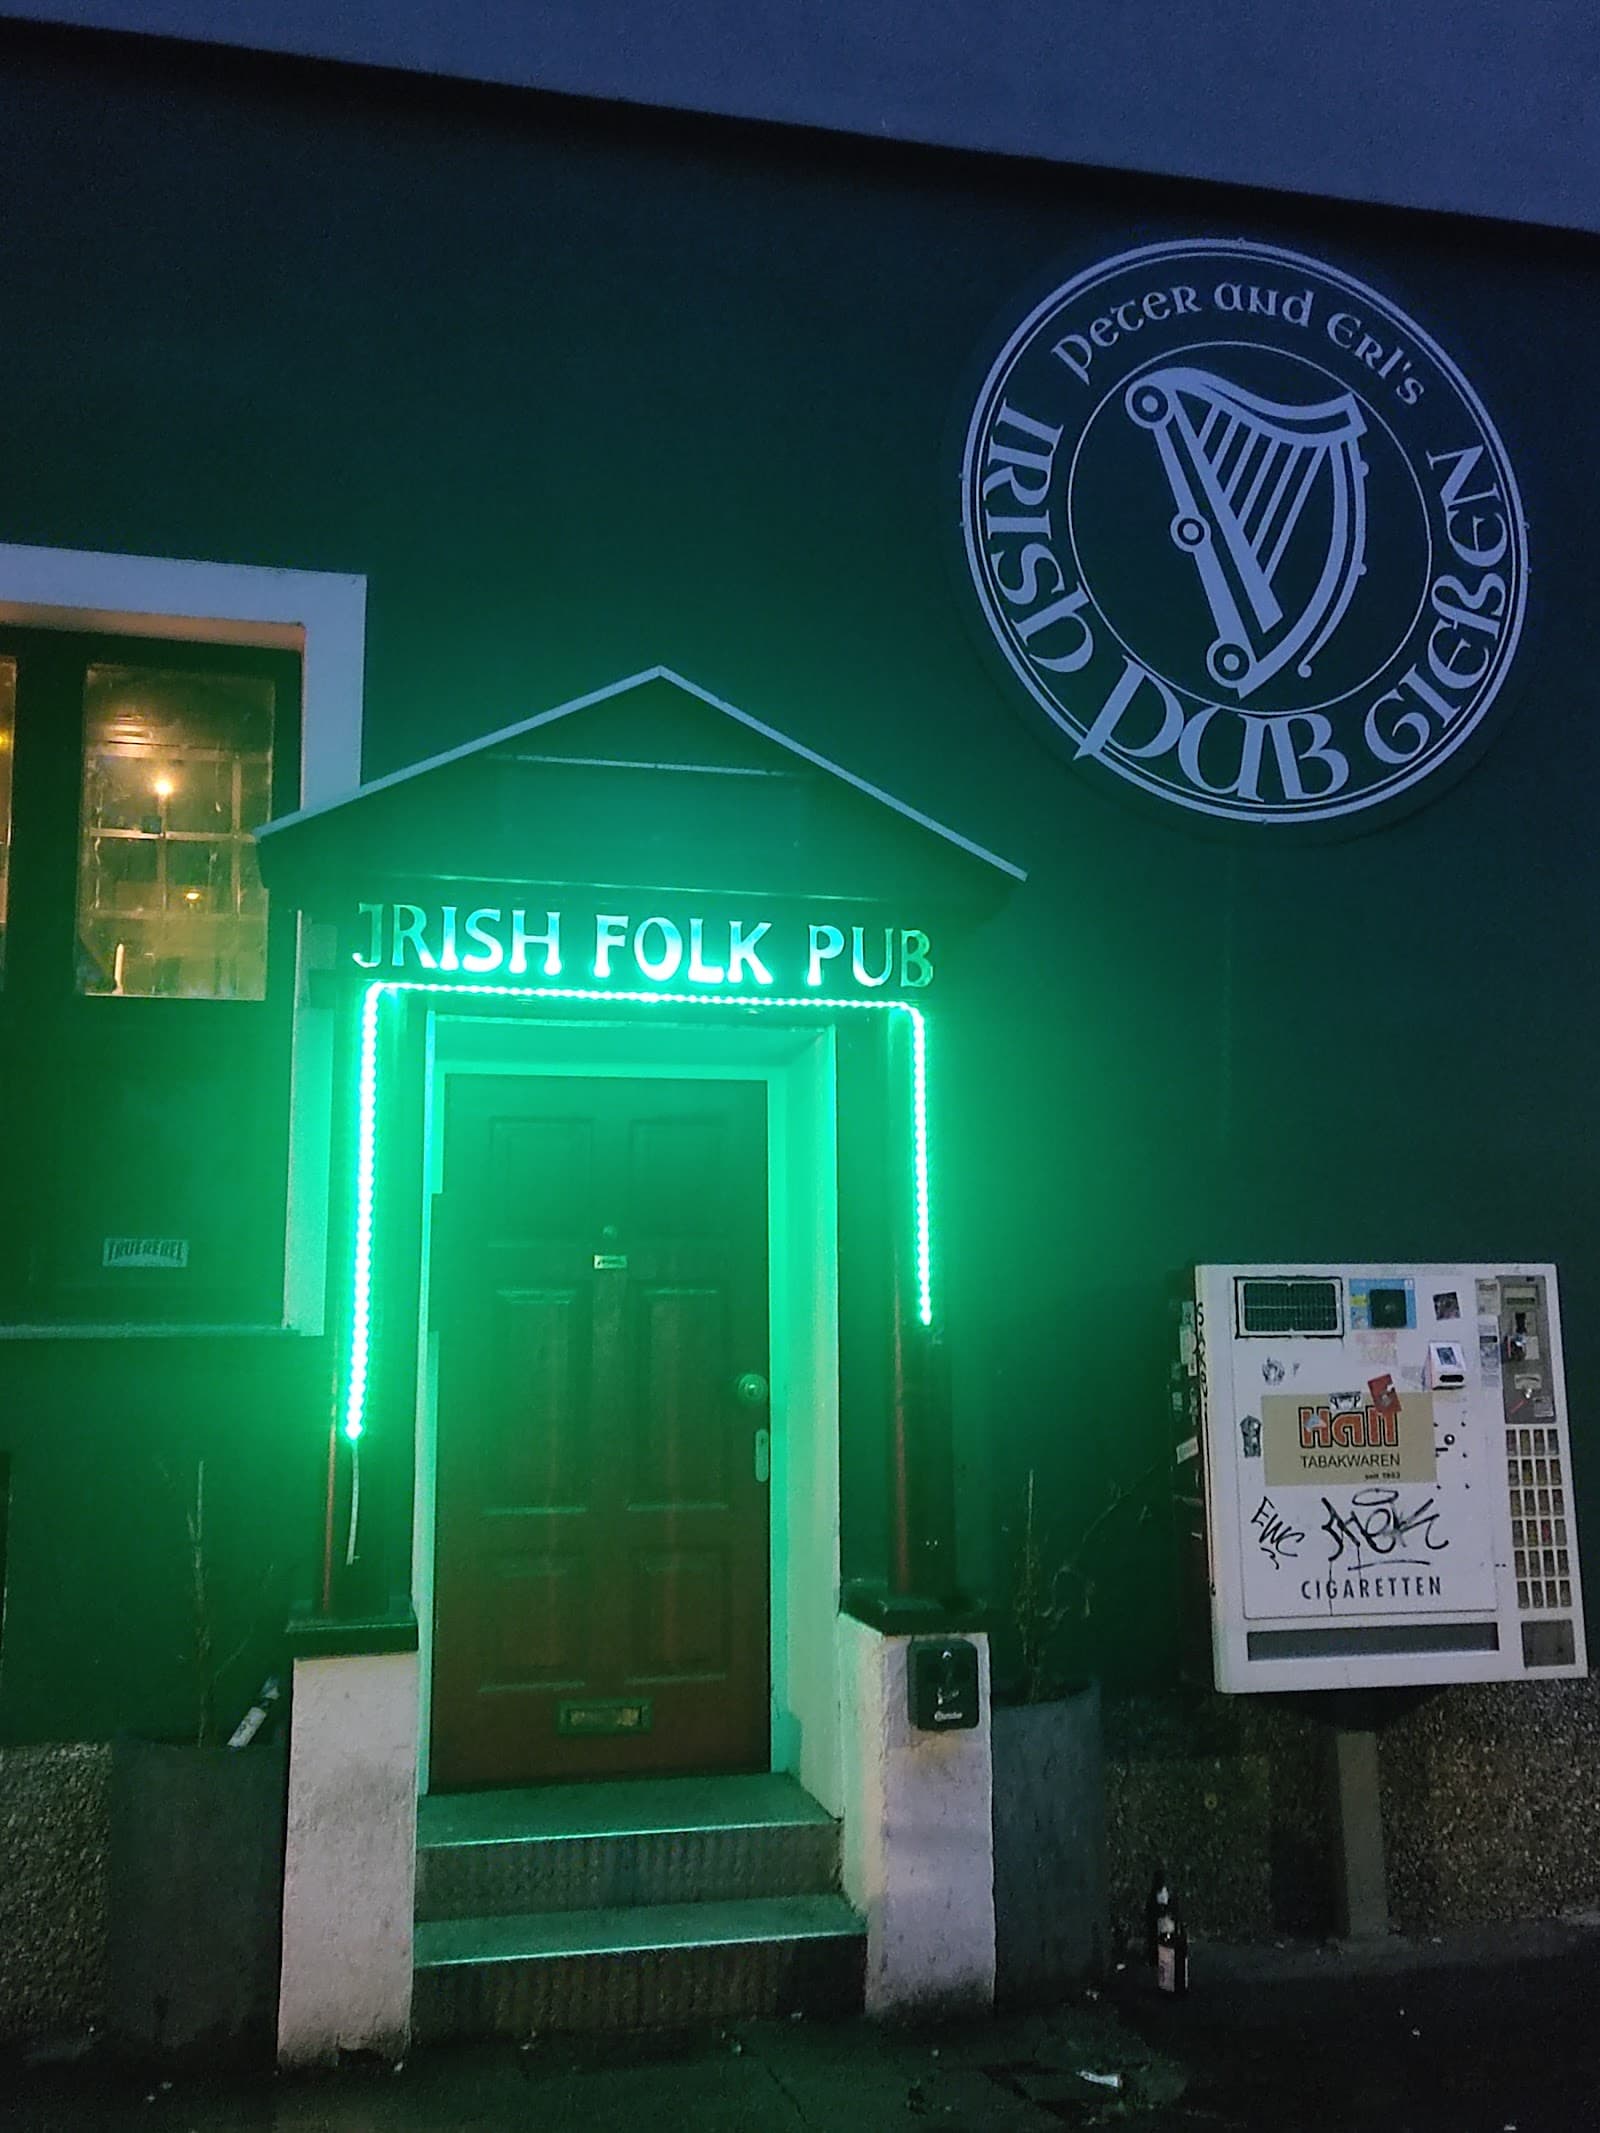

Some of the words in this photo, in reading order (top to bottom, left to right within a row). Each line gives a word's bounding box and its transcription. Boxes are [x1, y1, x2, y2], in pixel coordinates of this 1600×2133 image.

[1051, 286, 1201, 385] Peter
[1213, 282, 1314, 328] and
[1327, 312, 1424, 405] Erl's
[1073, 654, 1350, 802] PUB
[593, 914, 775, 985] FOLK
[806, 924, 934, 988] PUB
[1301, 1453, 1400, 1469] TABAKWAREN
[1302, 1576, 1441, 1600] CIGARETTEN
